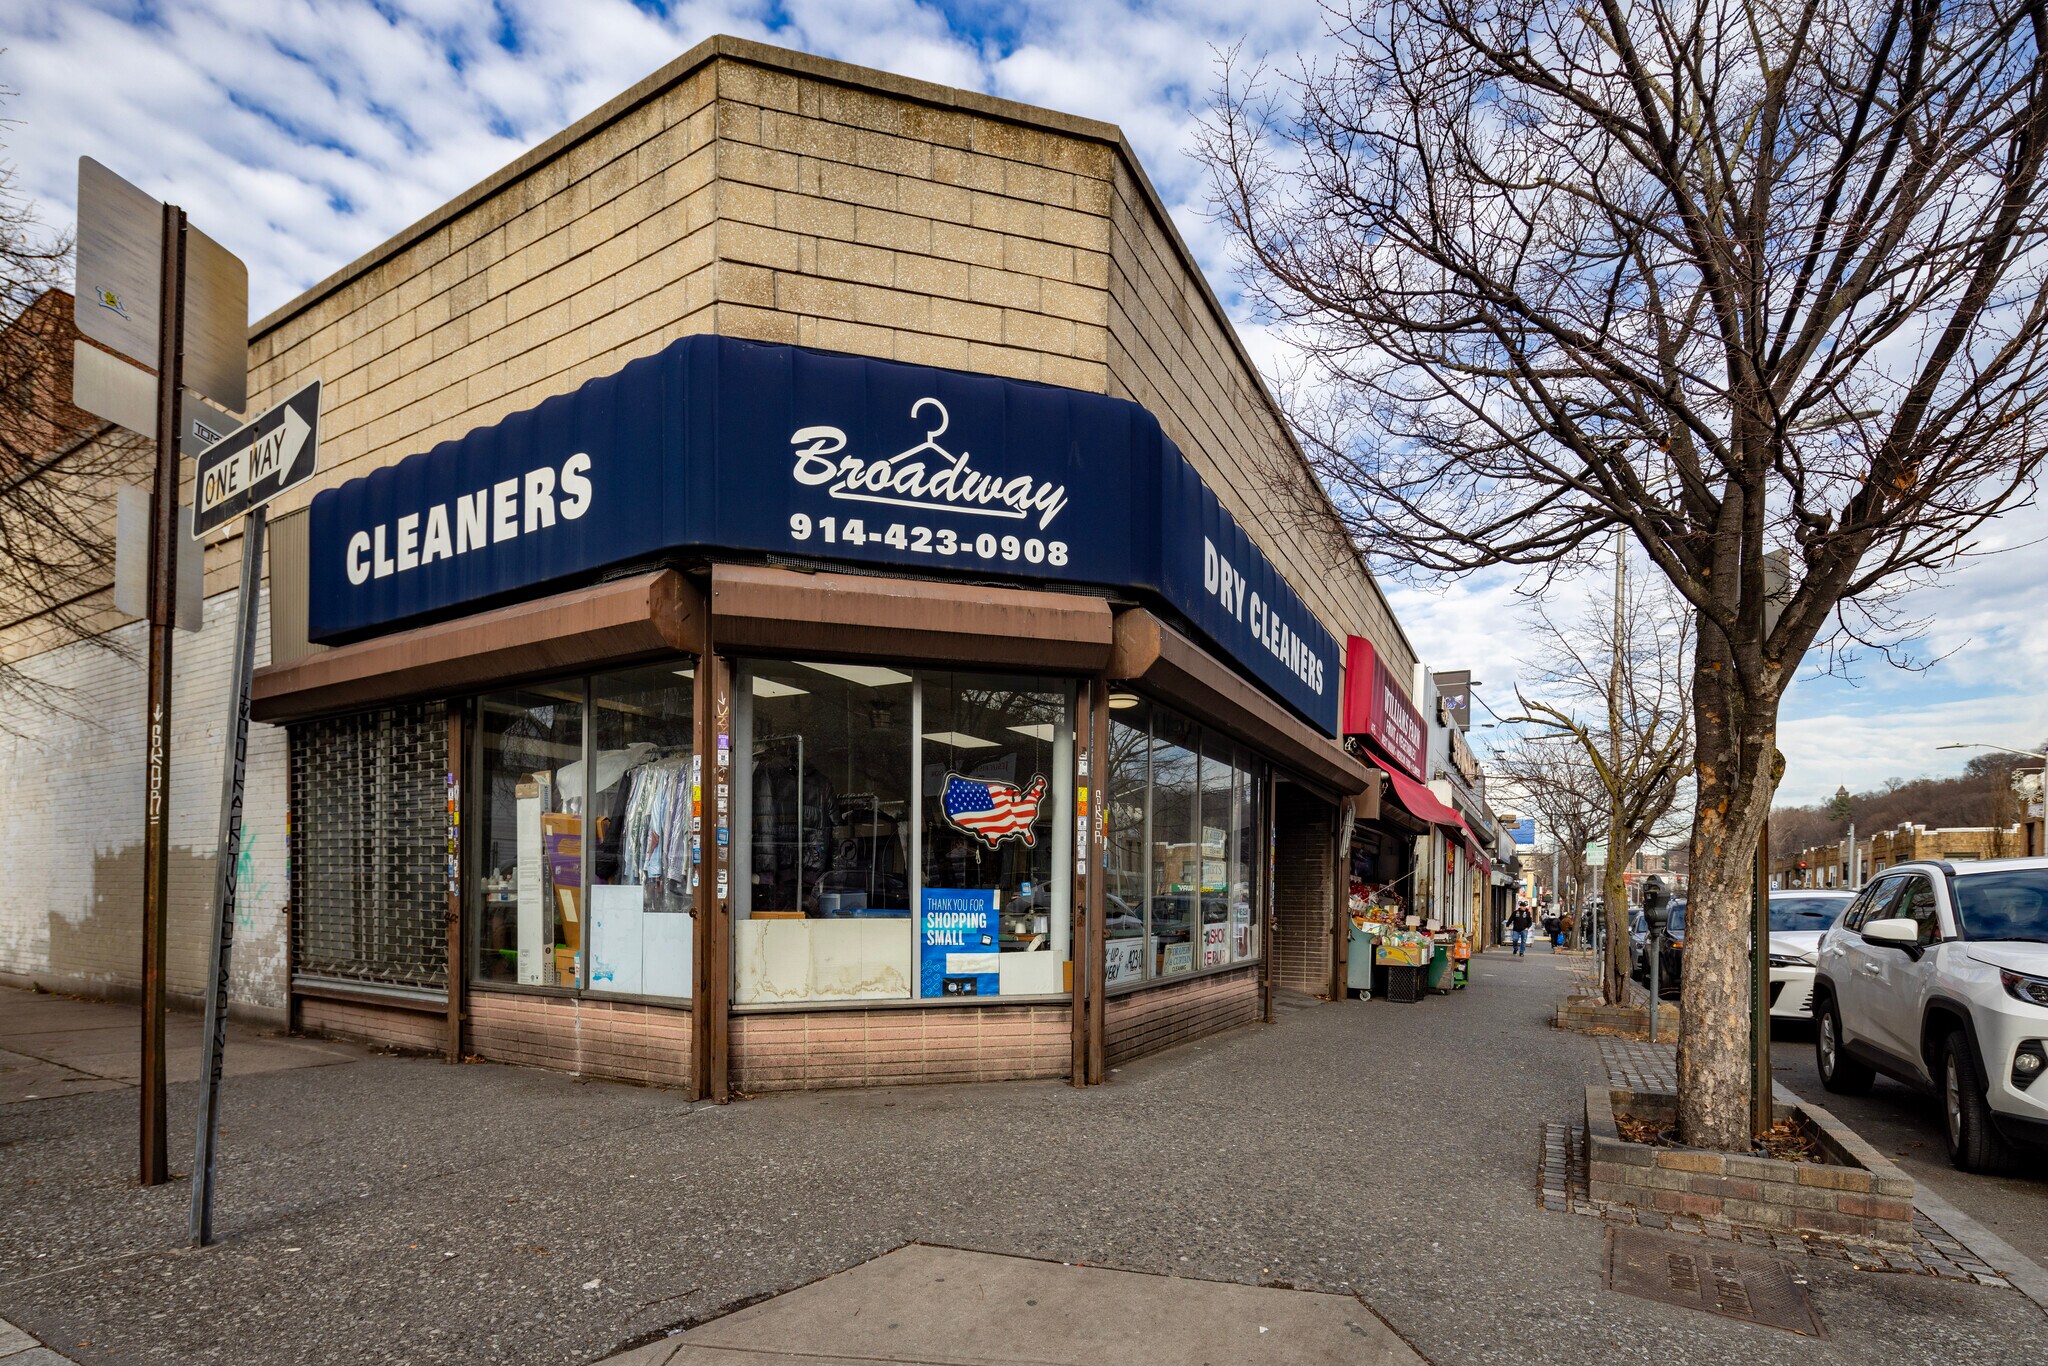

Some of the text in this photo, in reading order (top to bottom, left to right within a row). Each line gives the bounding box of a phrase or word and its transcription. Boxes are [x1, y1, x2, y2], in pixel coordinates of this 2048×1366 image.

[205, 427, 286, 505] ONE WAY
[790, 425, 1068, 531] Broadway
[346, 452, 593, 586] CLEANERS
[789, 512, 1069, 567] 914-423-0908
[1204, 535, 1324, 696] DRY CLEANERS
[927, 912, 986, 929] SHOPPING
[928, 898, 984, 911] THANK YOU FOR
[927, 930, 965, 946] SMALL
